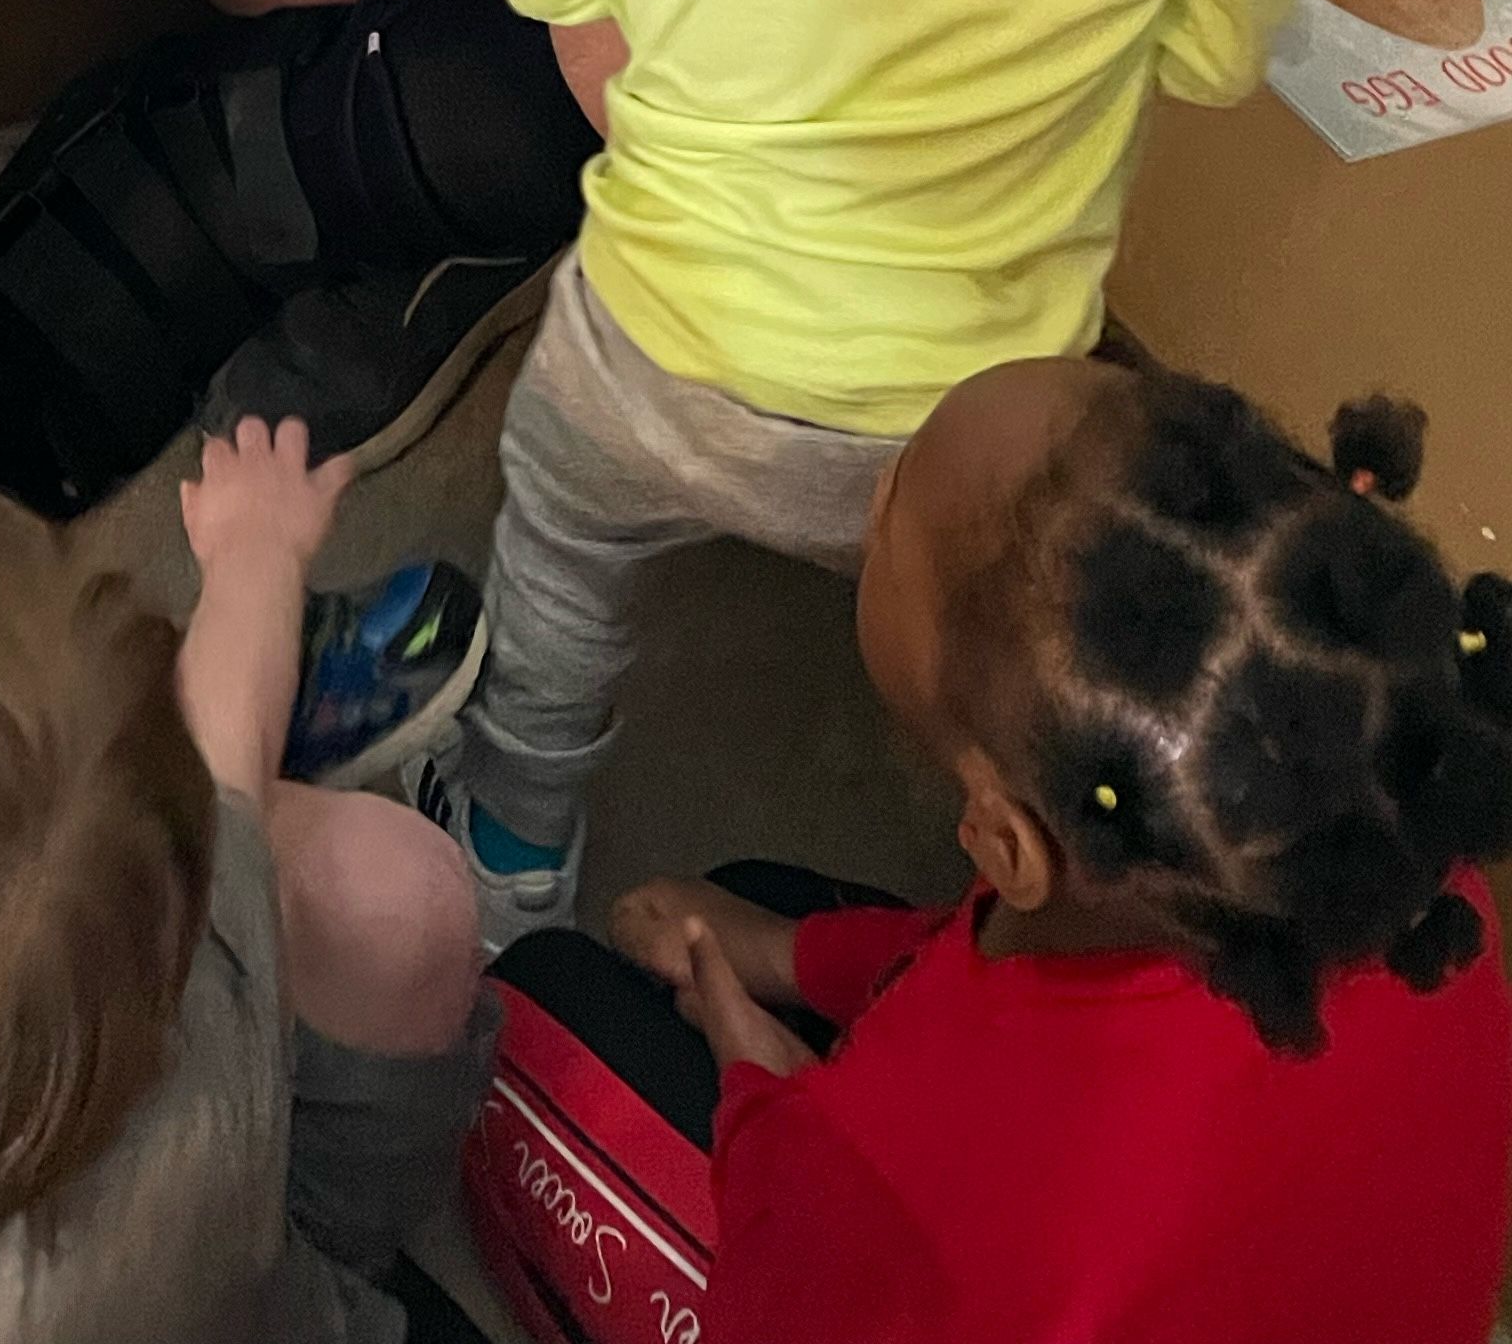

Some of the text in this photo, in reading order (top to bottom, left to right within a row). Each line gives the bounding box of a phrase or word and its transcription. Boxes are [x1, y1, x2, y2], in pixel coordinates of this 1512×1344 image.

[1341, 36, 1512, 118] OOD EGG
[512, 1139, 628, 1306] Soccer
